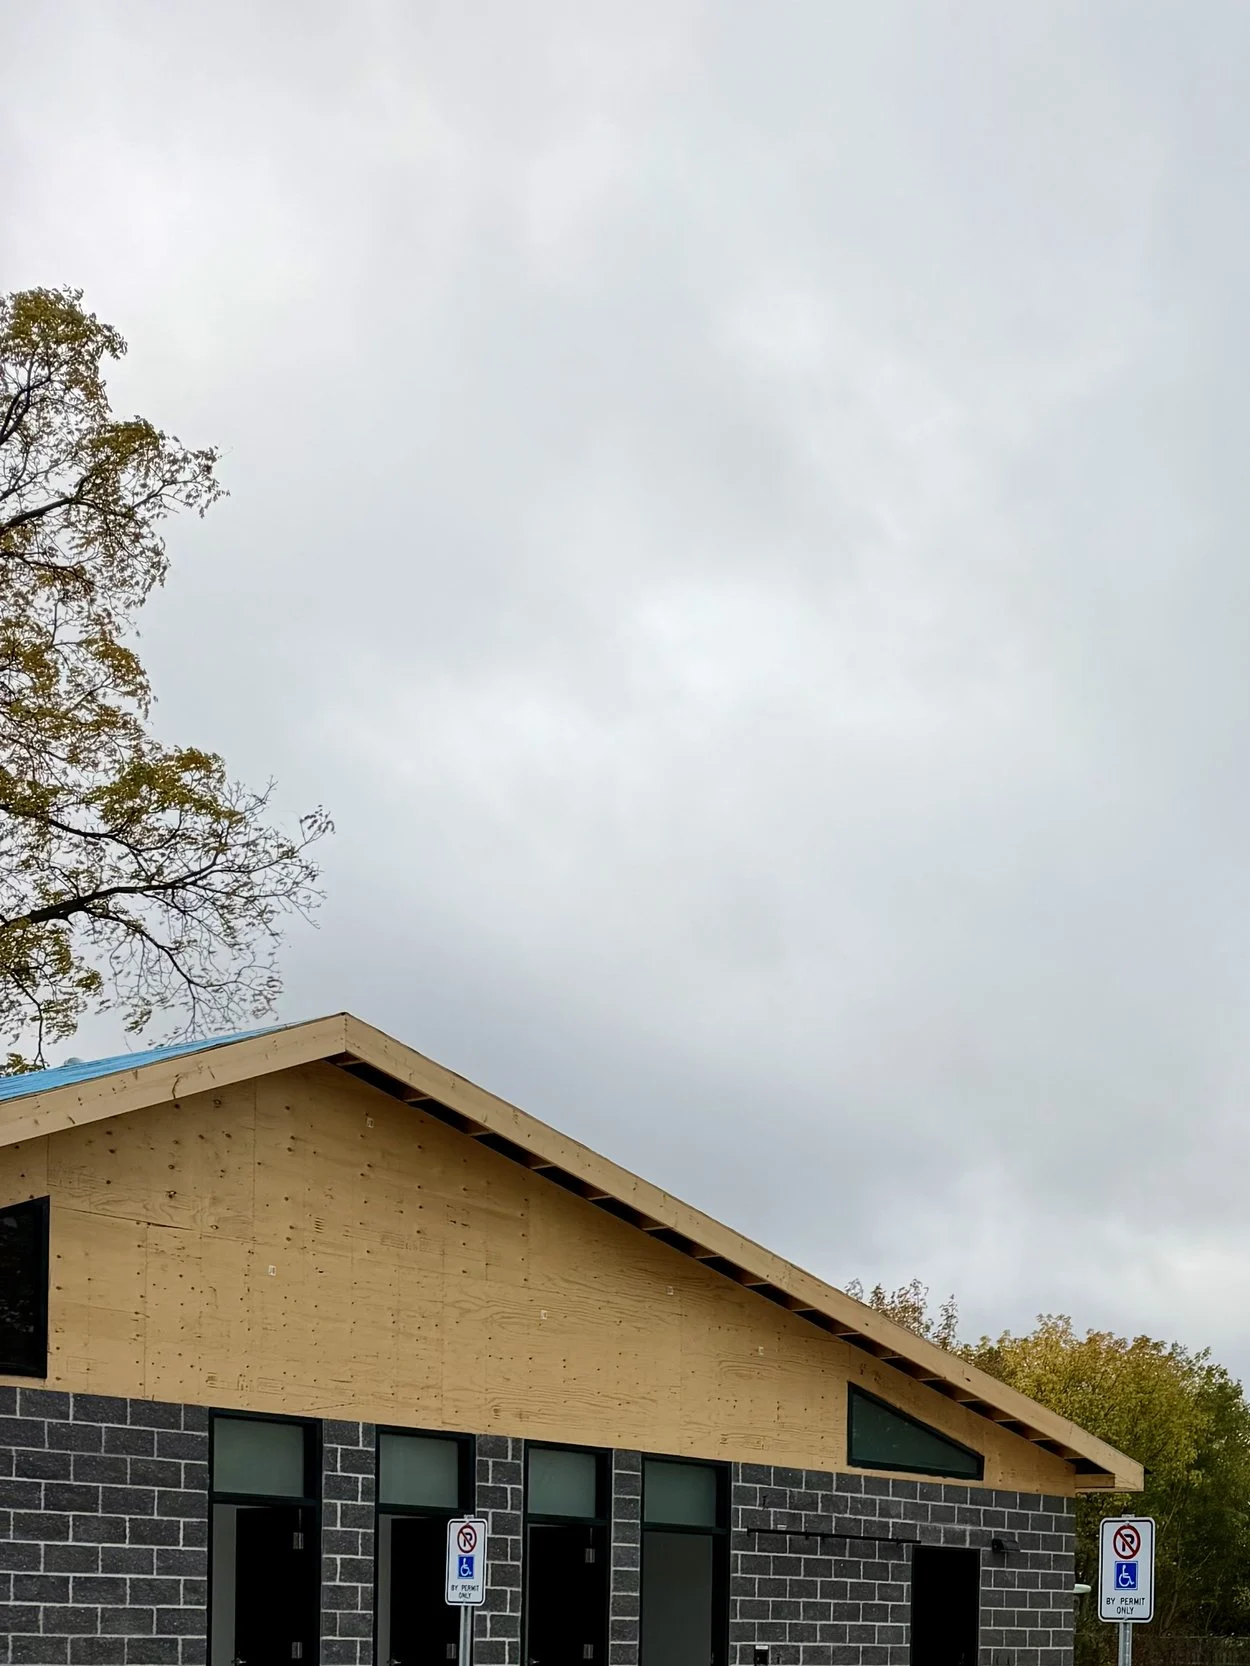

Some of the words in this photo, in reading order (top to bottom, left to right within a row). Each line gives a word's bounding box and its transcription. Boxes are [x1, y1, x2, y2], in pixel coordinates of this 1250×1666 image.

[1106, 1597, 1116, 1605] BY
[1120, 1597, 1145, 1605] PERMIT
[1116, 1606, 1135, 1615] ONLY
